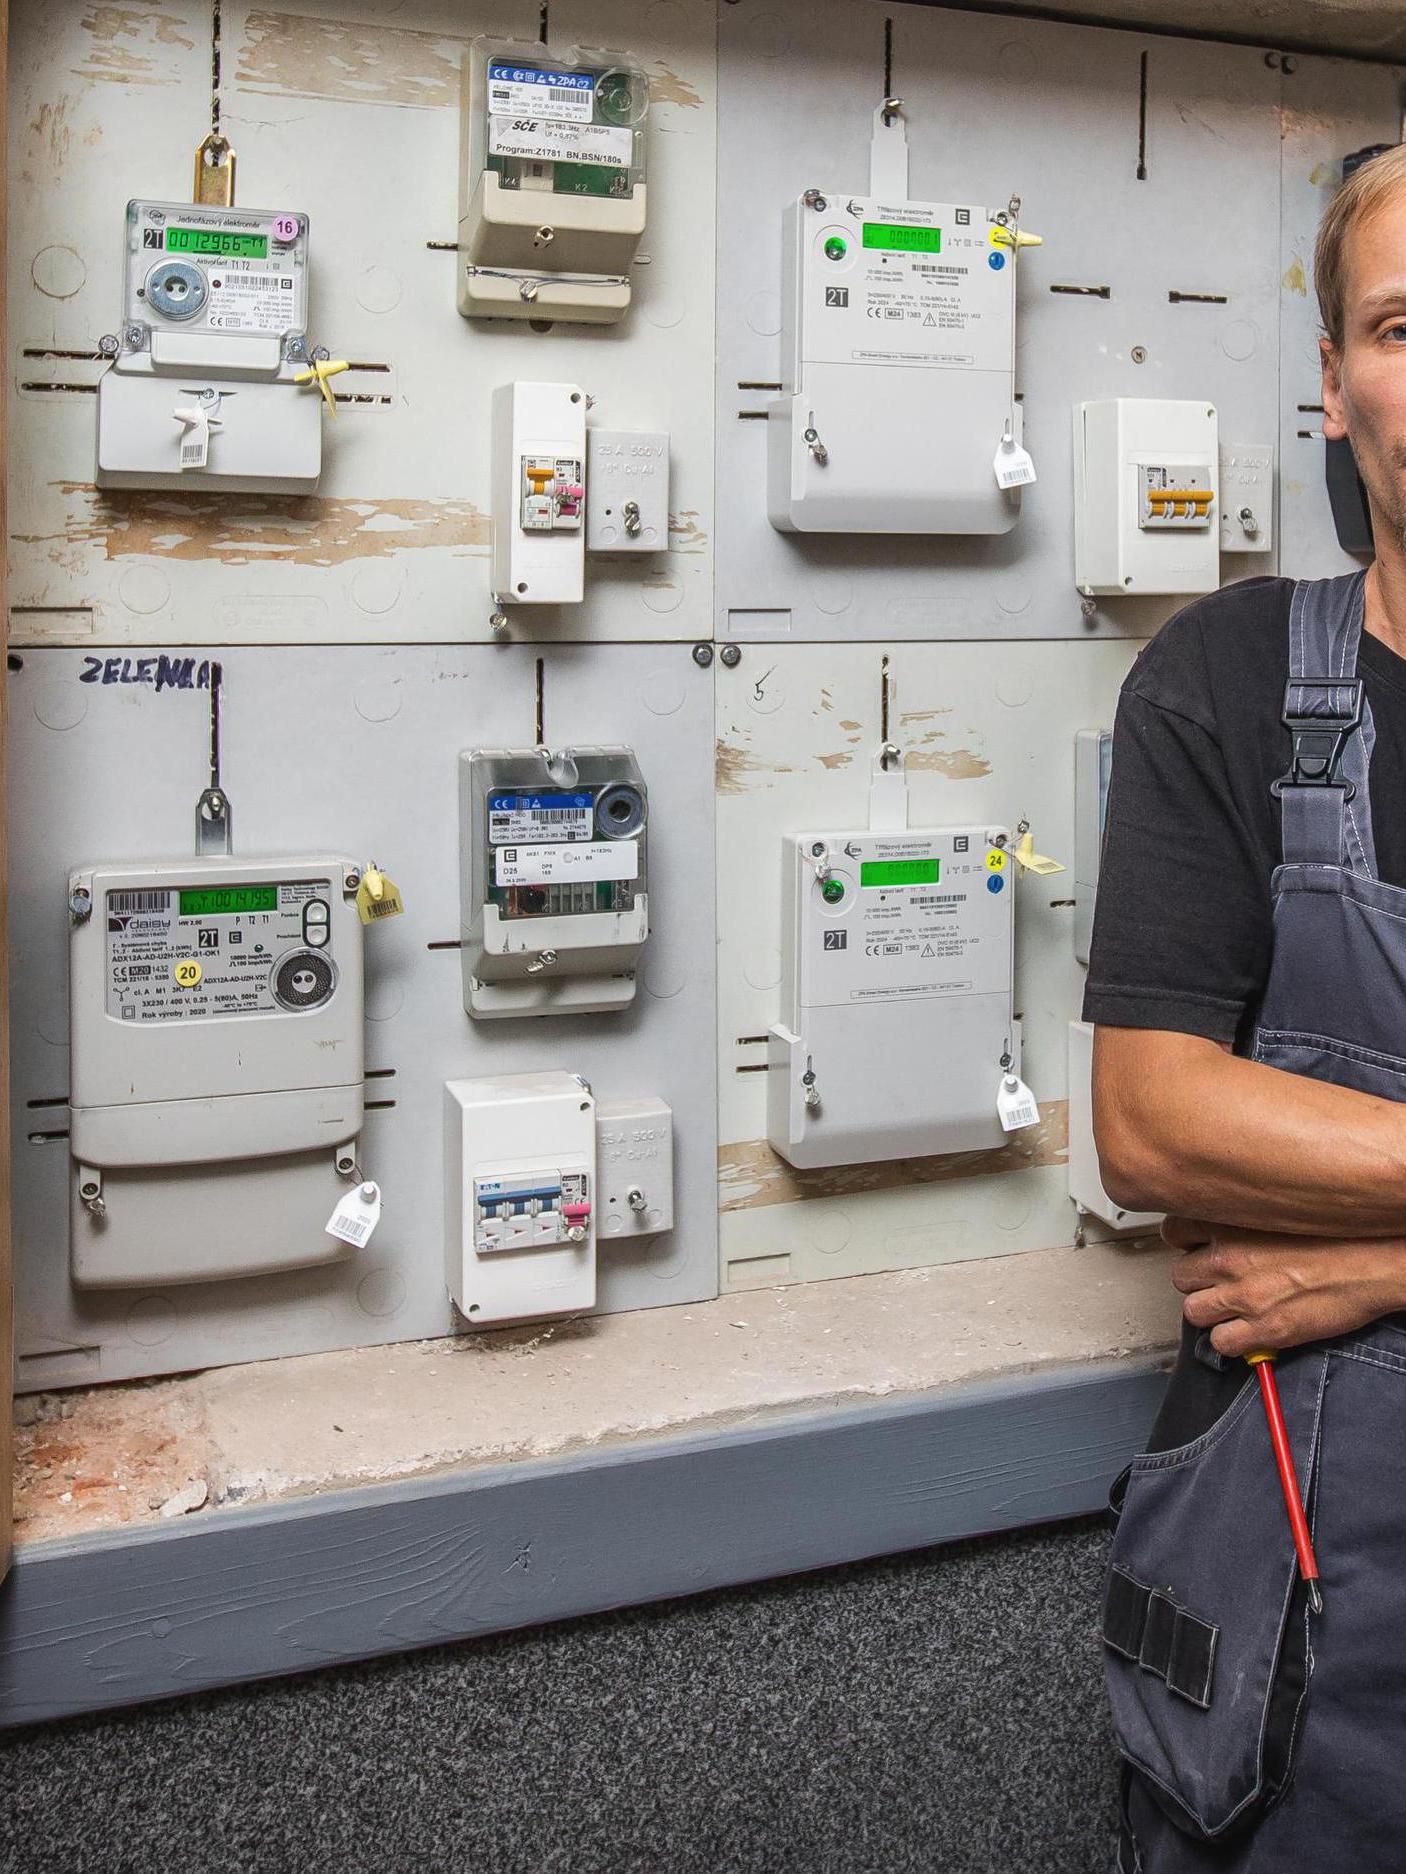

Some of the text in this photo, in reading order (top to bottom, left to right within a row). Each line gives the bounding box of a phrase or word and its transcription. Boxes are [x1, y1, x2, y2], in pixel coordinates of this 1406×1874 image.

[557, 76, 576, 86] ZPA
[512, 119, 539, 132] SČE
[496, 143, 561, 158] Program:Z1781
[277, 221, 293, 235] 16
[144, 228, 164, 249] 2T
[242, 261, 250, 271] T2
[826, 287, 849, 307] 2T
[990, 855, 1002, 866] 24
[130, 919, 171, 930] daisy
[249, 916, 256, 925] T2
[262, 915, 269, 924] T1
[199, 930, 218, 946] 2T
[825, 931, 847, 950] 2T
[885, 945, 900, 954] M24
[130, 966, 151, 976] M20
[152, 965, 169, 973] 1432
[180, 966, 197, 980] 20
[142, 998, 164, 1007] 3X230
[142, 1011, 157, 1019] Rok
[159, 1009, 183, 1020] výroby
[189, 1008, 206, 1016] 2020
